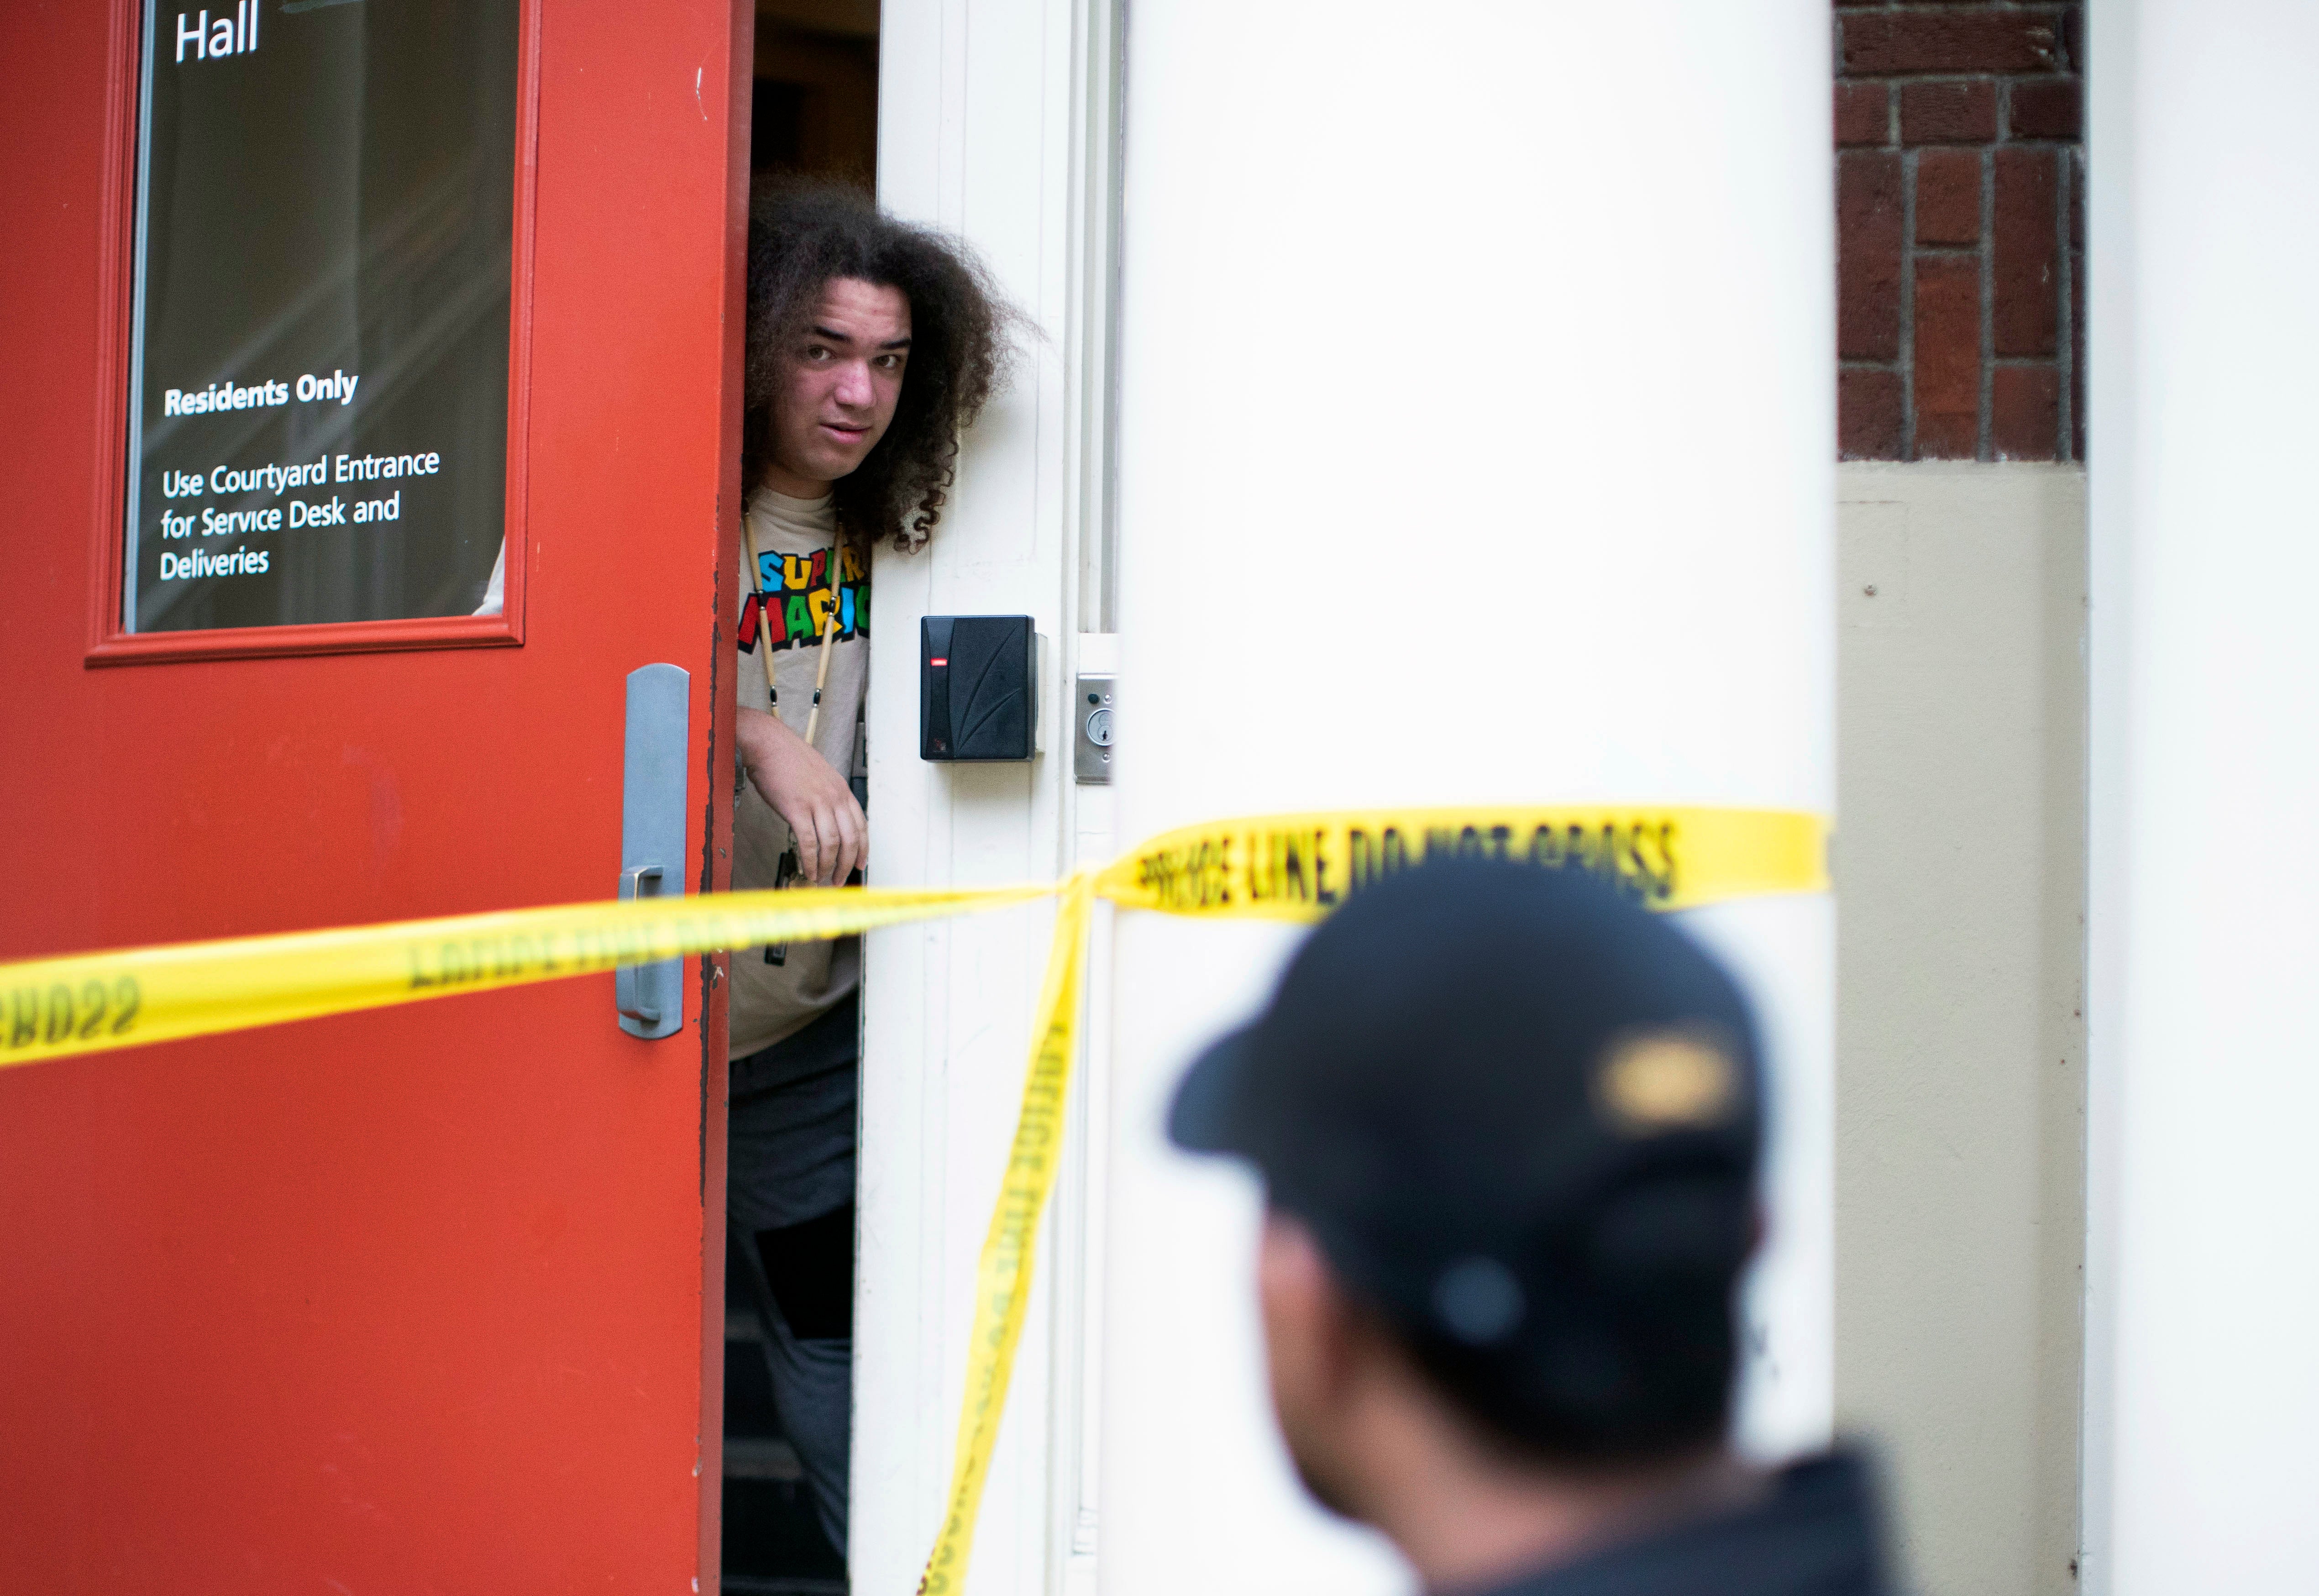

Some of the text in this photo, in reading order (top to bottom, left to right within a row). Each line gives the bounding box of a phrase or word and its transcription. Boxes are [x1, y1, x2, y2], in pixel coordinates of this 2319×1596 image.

[176, 0, 259, 63] Hall
[164, 369, 359, 417] Residents Only
[163, 452, 441, 499] Use Courtyard Entrance
[160, 490, 400, 539] for Service Desk and
[160, 546, 269, 581] Deliveries
[1245, 829, 1337, 906] LINE
